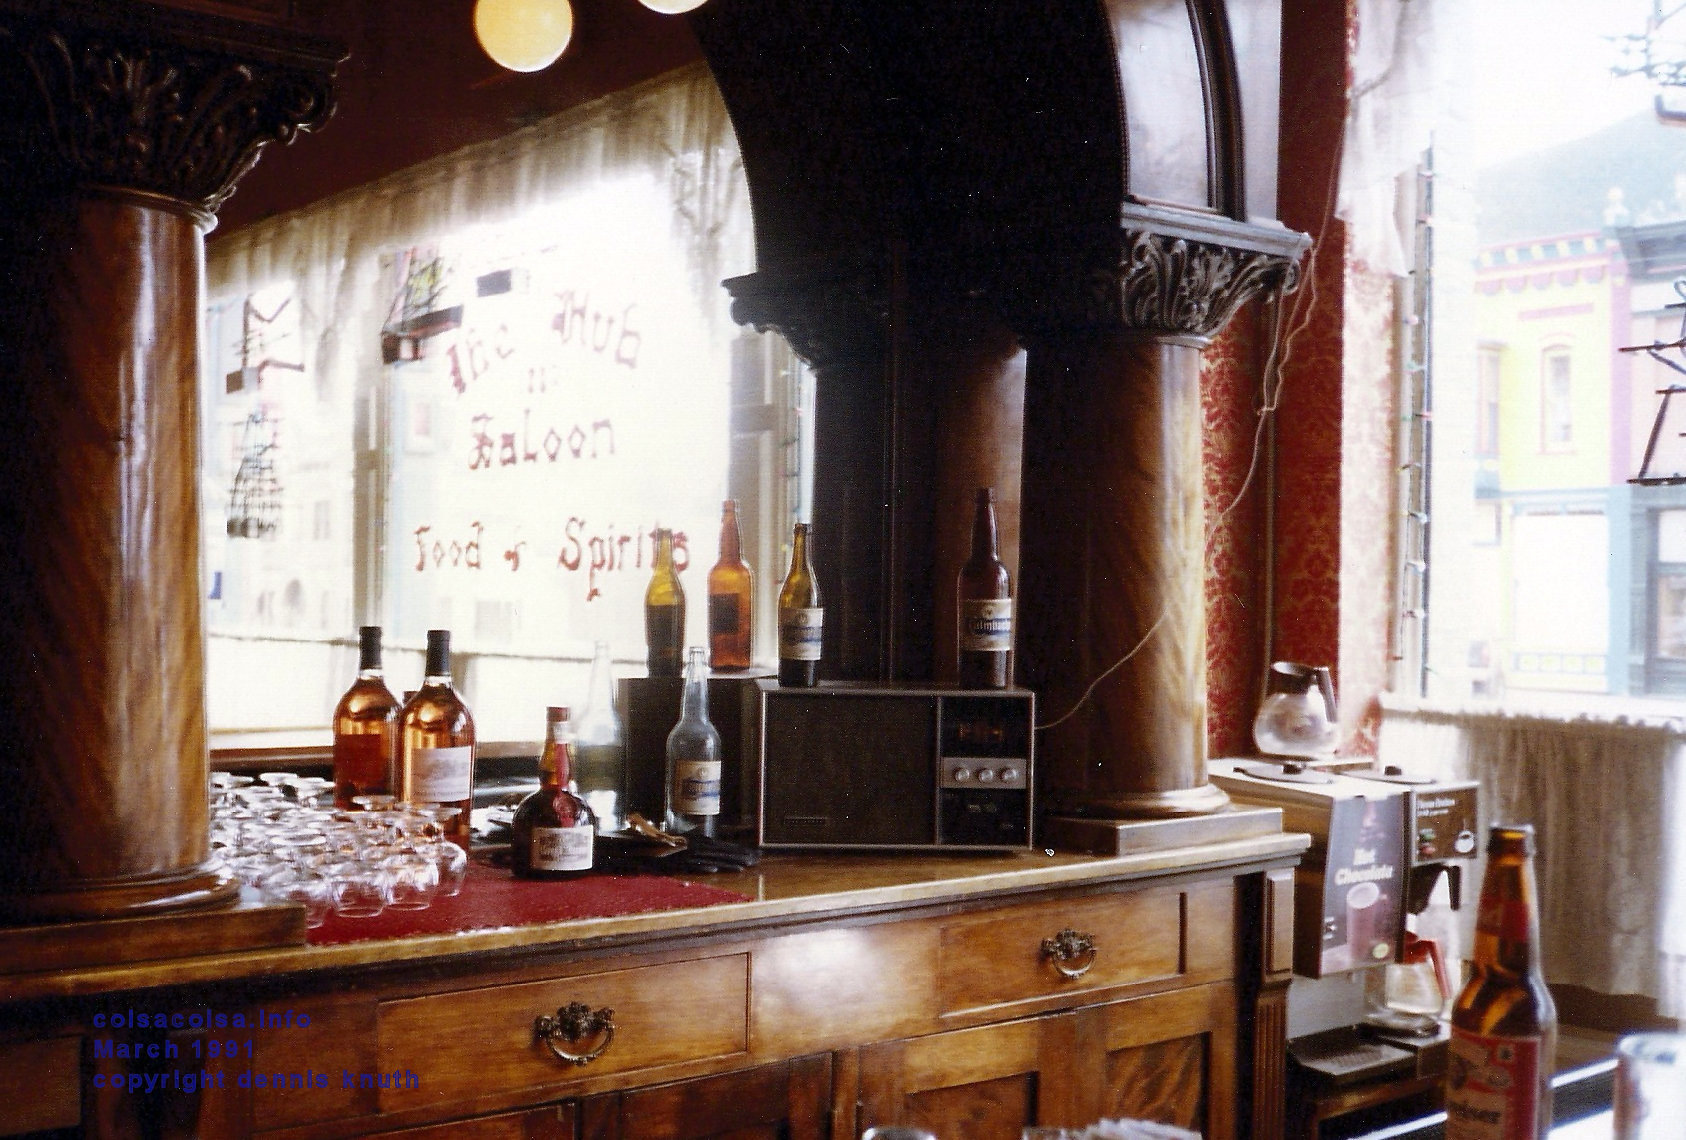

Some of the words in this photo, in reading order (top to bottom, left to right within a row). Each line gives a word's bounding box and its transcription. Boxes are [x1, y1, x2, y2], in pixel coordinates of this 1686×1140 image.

[551, 289, 641, 369] Hub
[468, 408, 614, 470] Saloon
[413, 520, 484, 573] Food
